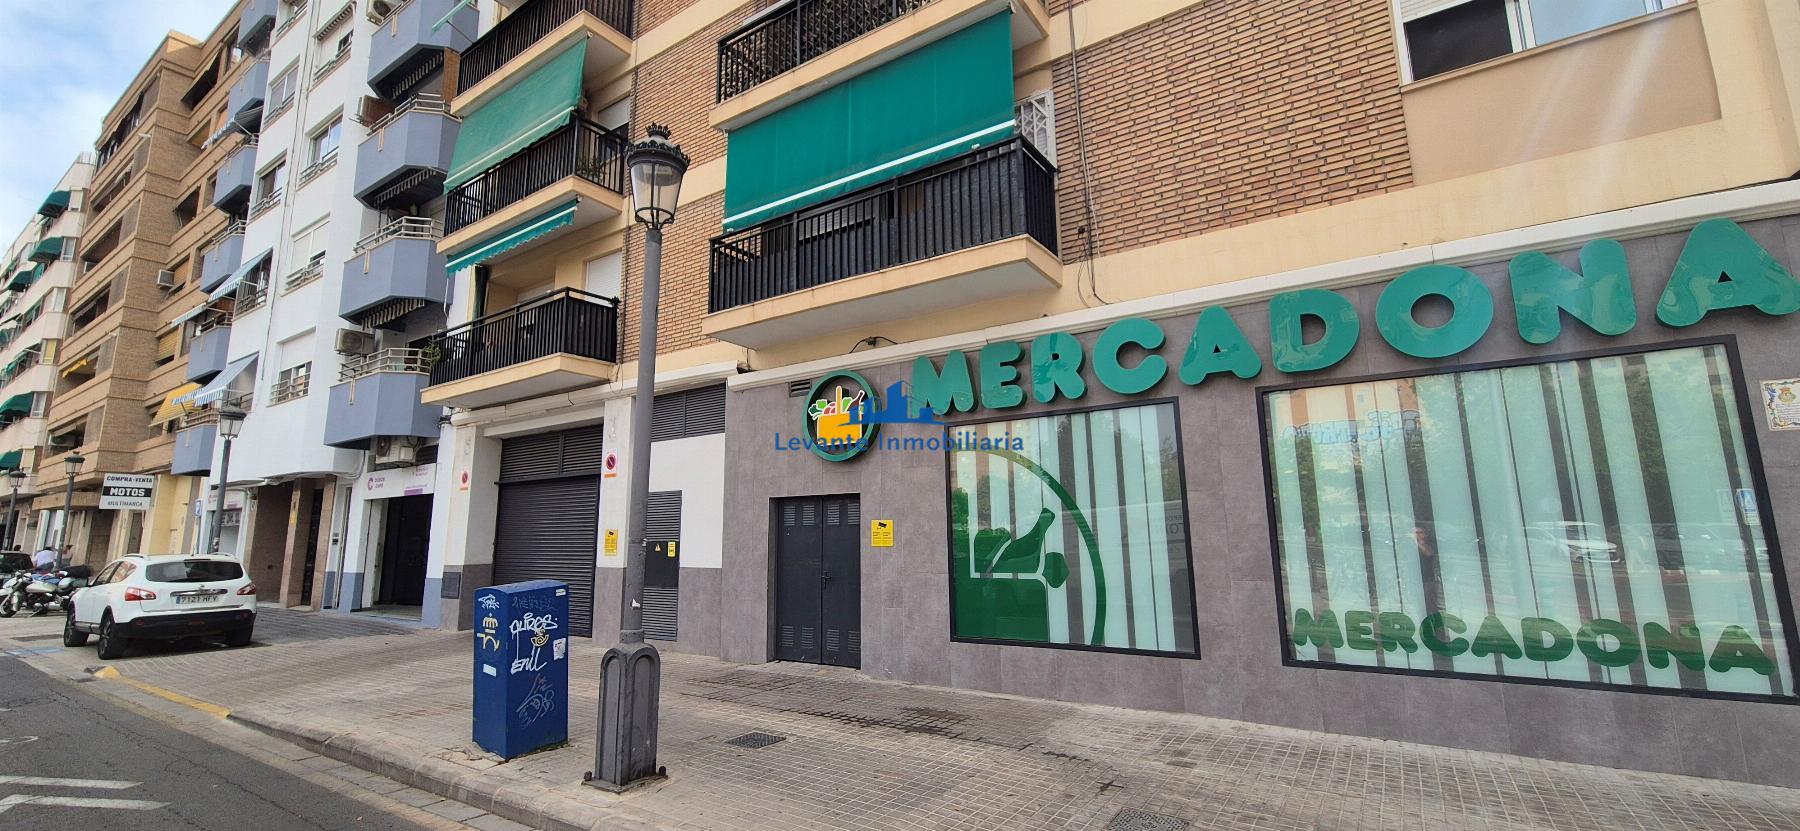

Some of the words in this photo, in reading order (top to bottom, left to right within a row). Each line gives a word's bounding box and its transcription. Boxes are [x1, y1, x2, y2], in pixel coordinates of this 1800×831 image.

[911, 217, 1800, 418] MERCADONA
[109, 487, 146, 497] MOTOS
[1293, 607, 1777, 676] MERCADONA
